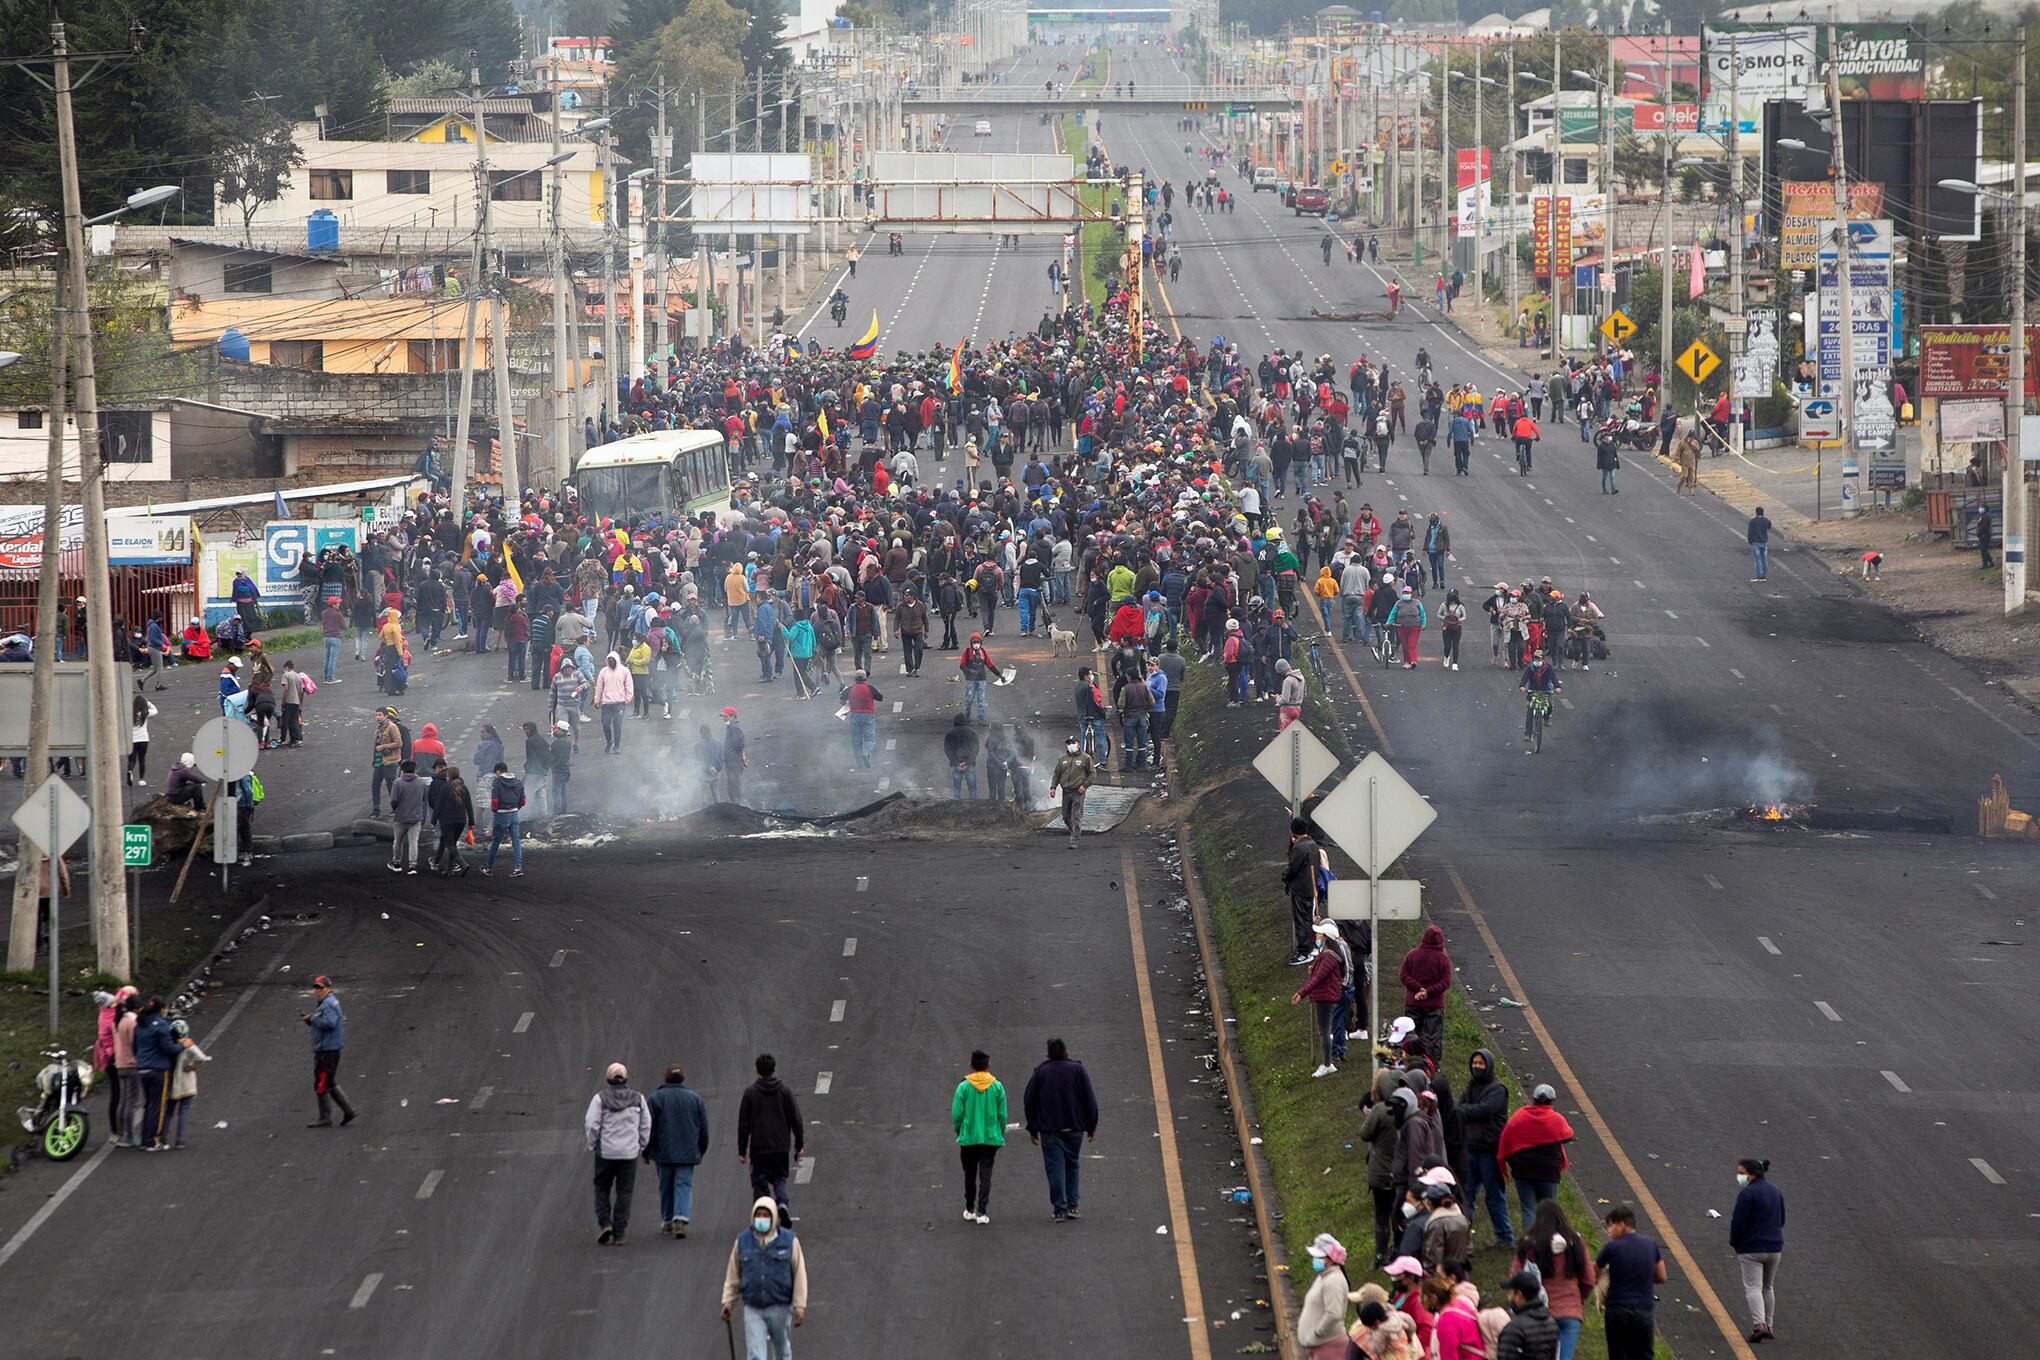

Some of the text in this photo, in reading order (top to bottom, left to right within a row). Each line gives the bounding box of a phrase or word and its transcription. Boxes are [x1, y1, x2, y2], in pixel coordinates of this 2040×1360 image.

[1837, 39, 1908, 60] MAYOR
[1717, 54, 1805, 70] CSMO-R
[1820, 59, 1923, 76] PODUCTIVIDAD
[1786, 183, 1879, 196] Restaante
[1786, 234, 1818, 246] ALMUE
[1785, 252, 1817, 263] PLATOS
[1821, 309, 1862, 317] AMAZAS
[1852, 322, 1881, 332] ORAS
[509, 358, 550, 373] BUELITA
[1854, 423, 1895, 431] DESAYUNOS
[0, 540, 43, 553] Kendal
[125, 831, 147, 842] km
[125, 846, 147, 859] 297
